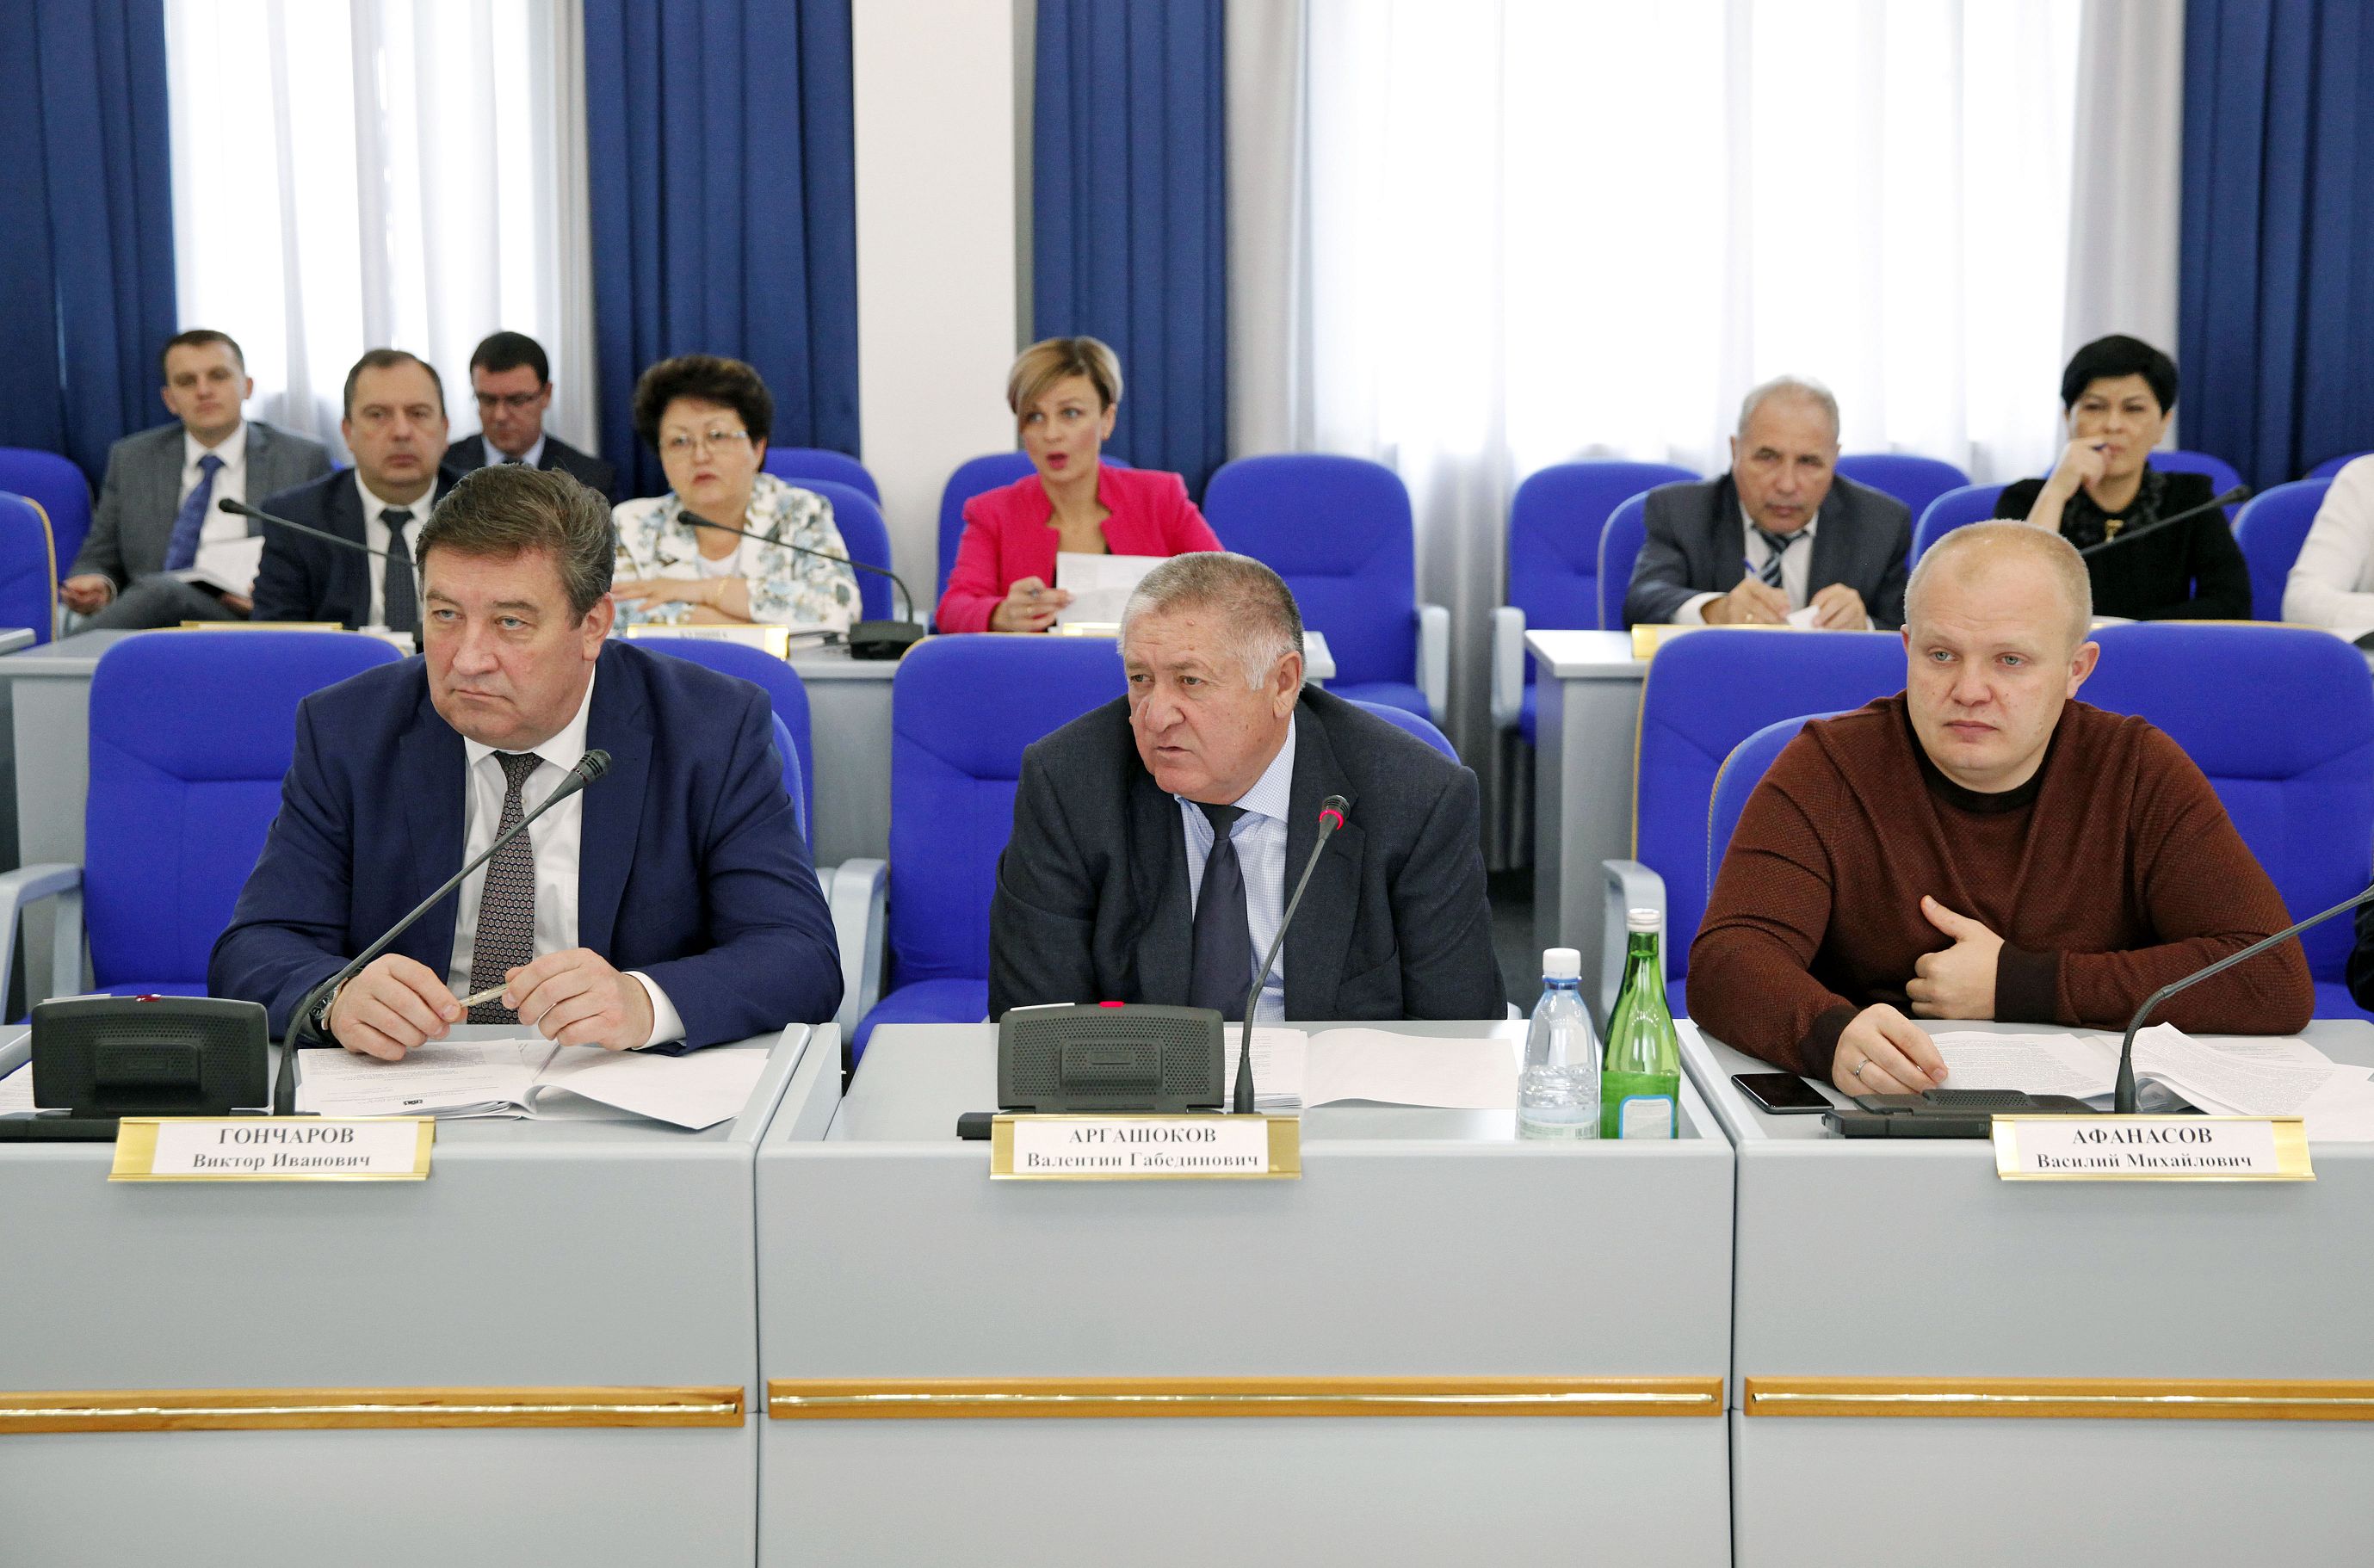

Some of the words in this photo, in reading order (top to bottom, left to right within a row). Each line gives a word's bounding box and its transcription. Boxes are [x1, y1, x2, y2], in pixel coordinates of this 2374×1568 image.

[218, 1127, 355, 1145] ГОНЧАРОВ
[1069, 1127, 1216, 1143] АРГАШОКОВ
[2073, 1127, 2213, 1144] АФАНАСОВ
[193, 1153, 265, 1171] Виктор
[272, 1152, 370, 1167] Иванович
[1027, 1152, 1122, 1167] Валентин
[1129, 1151, 1258, 1167] Габединович
[2037, 1153, 2119, 1168] Василий
[2127, 1153, 2252, 1168] Михайлович
